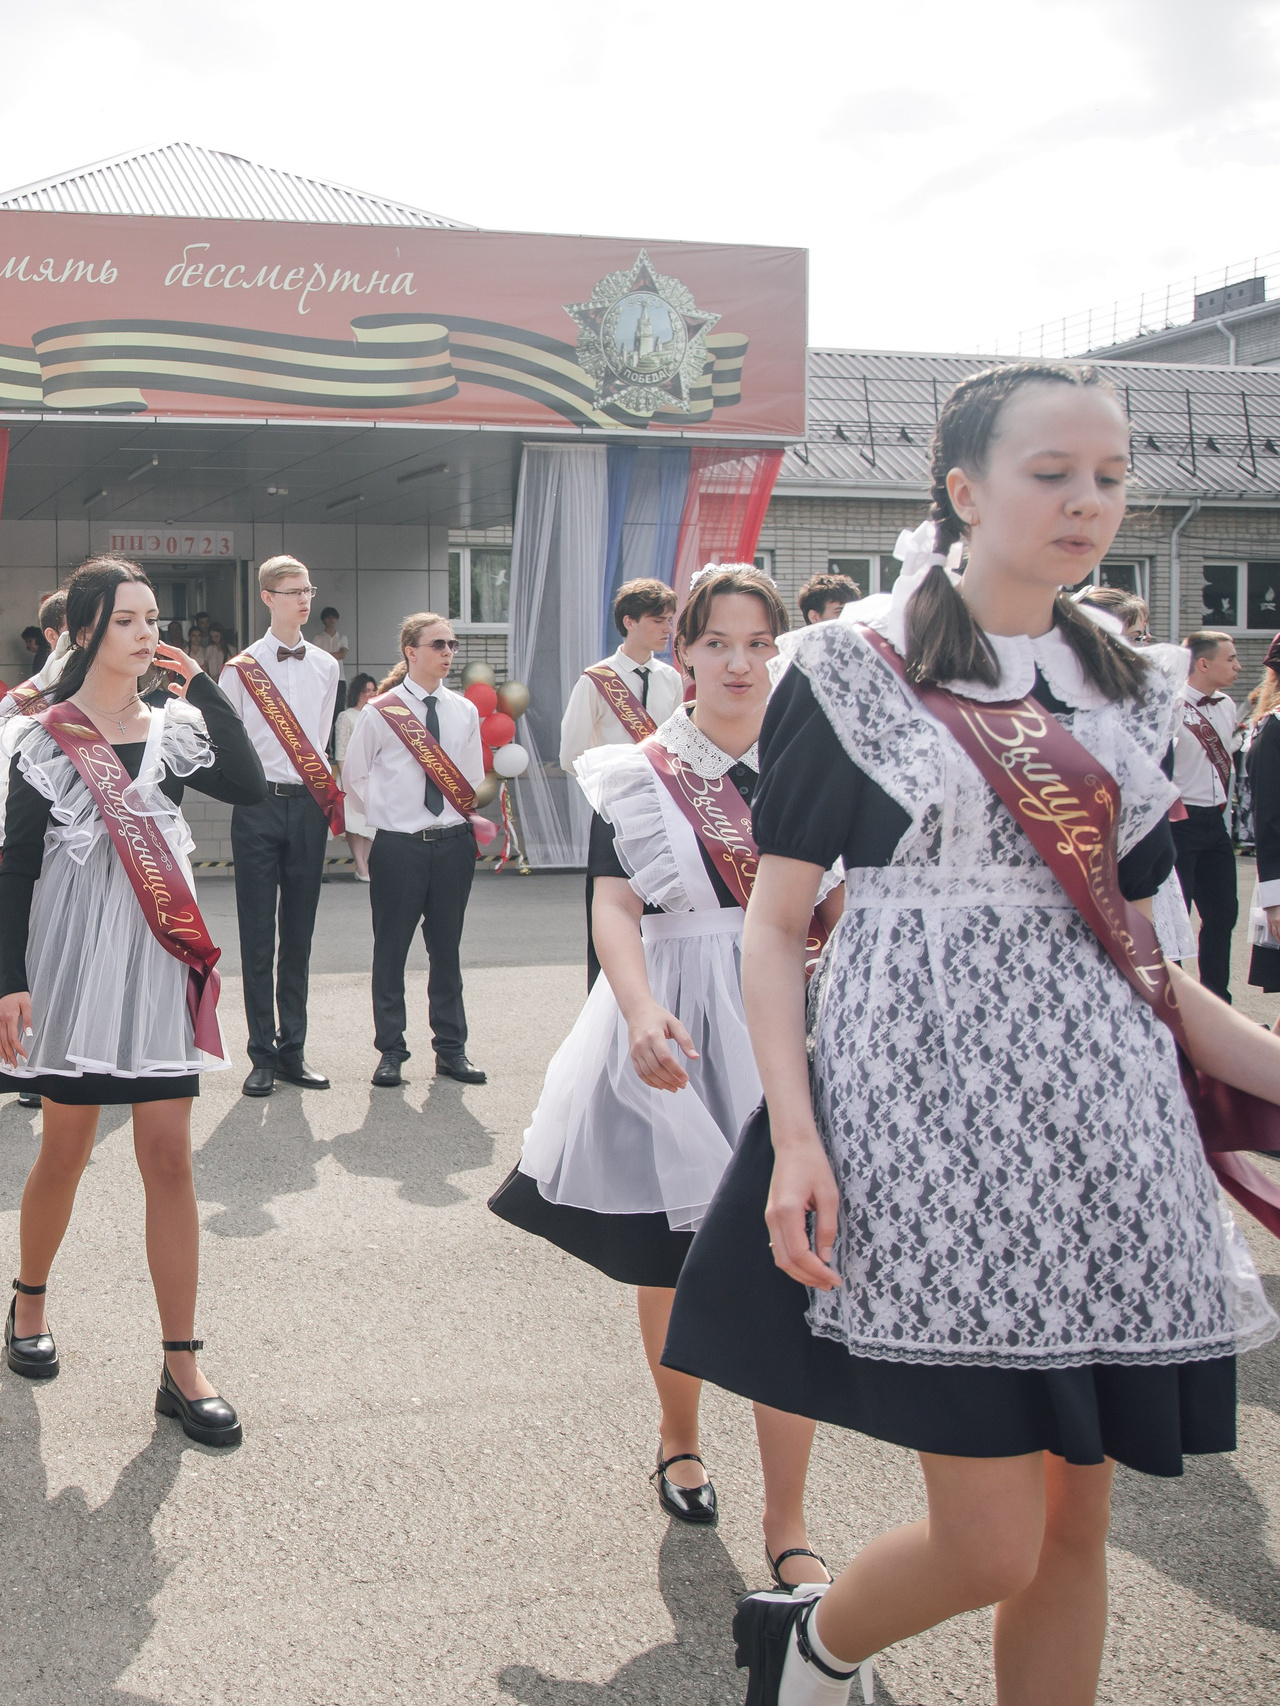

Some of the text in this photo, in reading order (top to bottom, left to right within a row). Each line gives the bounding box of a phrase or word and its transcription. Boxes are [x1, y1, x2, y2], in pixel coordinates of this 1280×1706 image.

[163, 242, 417, 315] бессмертна
[623, 368, 667, 383] ПОБЕДА
[245, 668, 326, 789] Выпускник 2026
[400, 719, 461, 796] Выпускник
[78, 744, 172, 905] Выпускница
